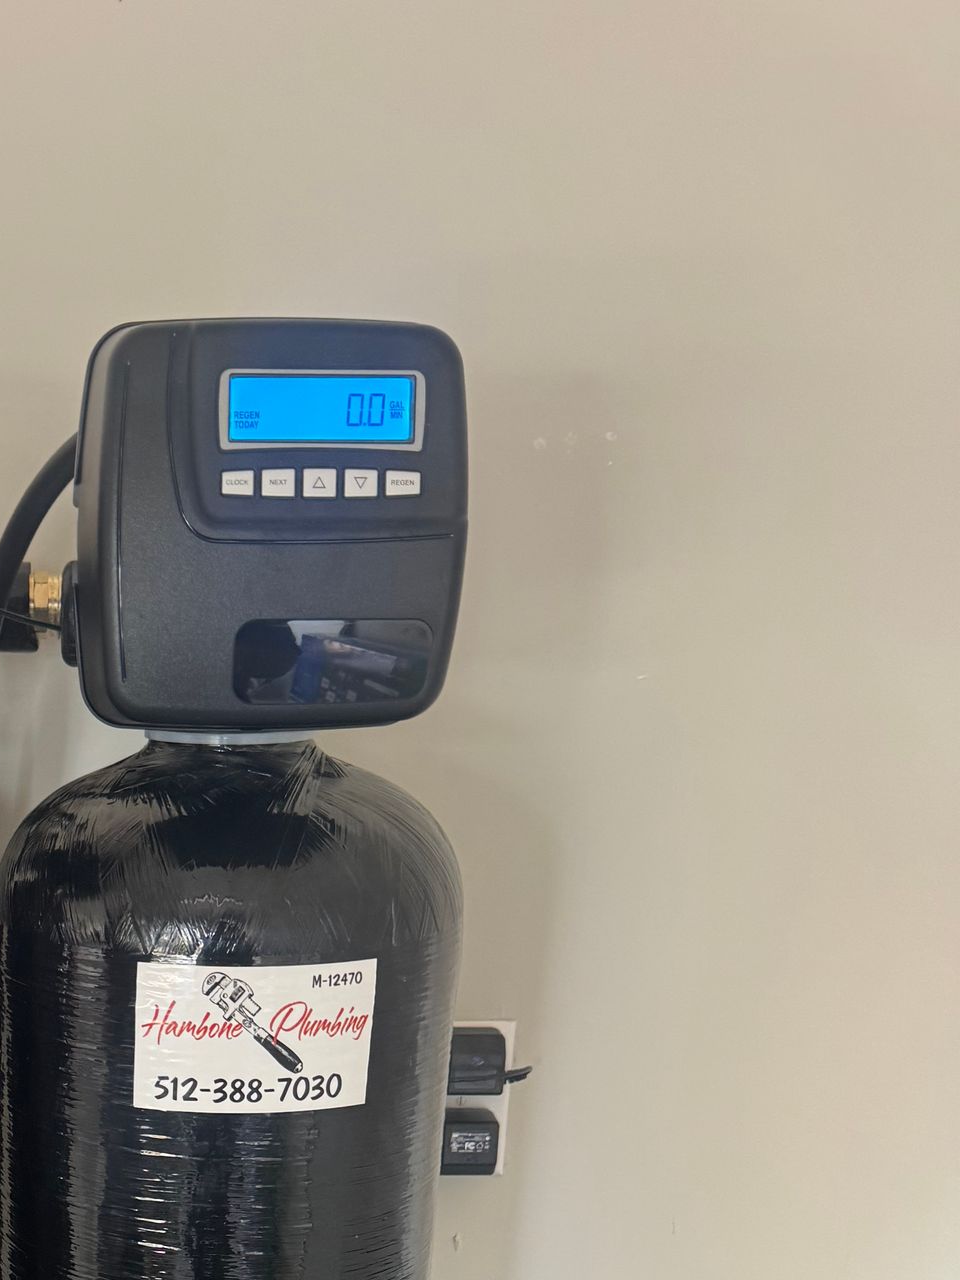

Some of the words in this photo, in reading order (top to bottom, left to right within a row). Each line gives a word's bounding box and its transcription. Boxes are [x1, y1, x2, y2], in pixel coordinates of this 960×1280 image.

[234, 411, 260, 420] REGEN
[346, 393, 386, 427] 0.0
[234, 420, 259, 429] TODAY
[311, 971, 363, 989] M-12470
[141, 1000, 244, 1045] Hambone
[269, 1001, 369, 1046] Plumbing
[153, 1073, 343, 1103] 512-388-7030
